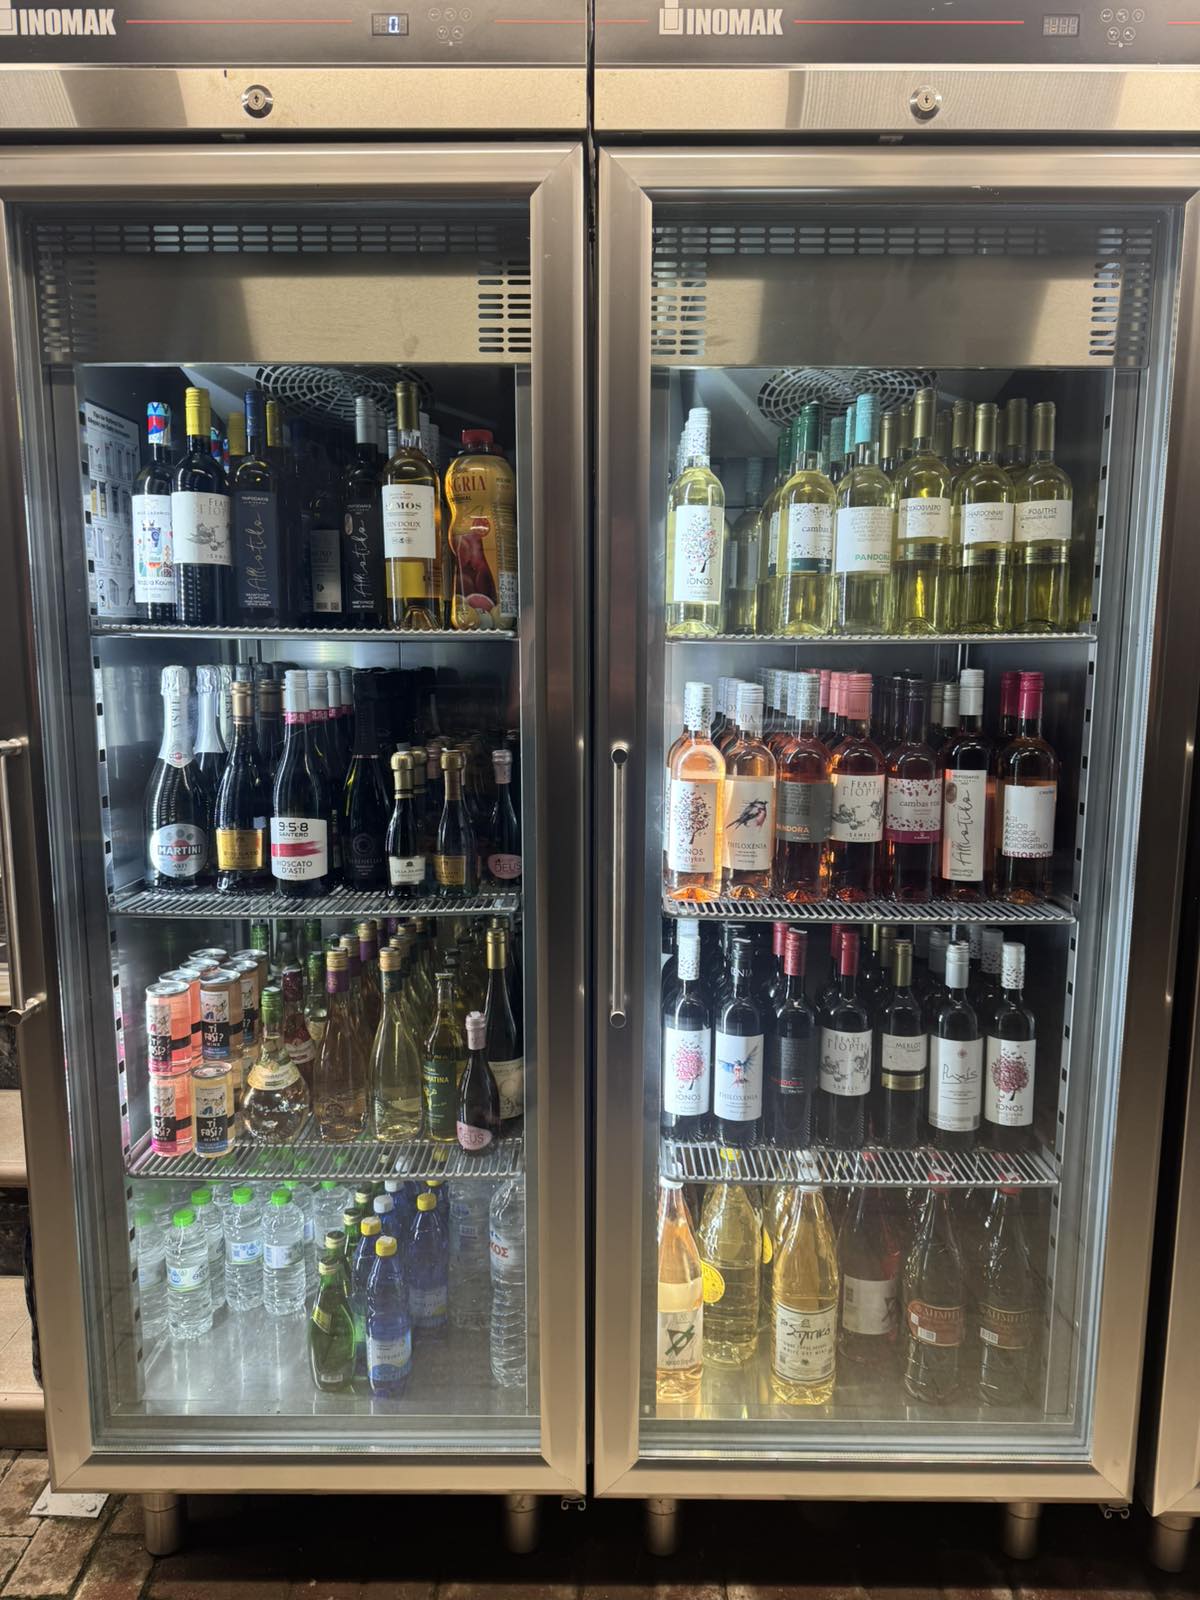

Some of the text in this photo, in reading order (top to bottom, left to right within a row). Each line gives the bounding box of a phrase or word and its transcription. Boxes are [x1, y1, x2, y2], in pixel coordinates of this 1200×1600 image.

[20, 9, 116, 36] INOMAK
[686, 9, 783, 36] INOMAK
[158, 845, 201, 856] MARTINI
[995, 1103, 1024, 1112] IONOS
